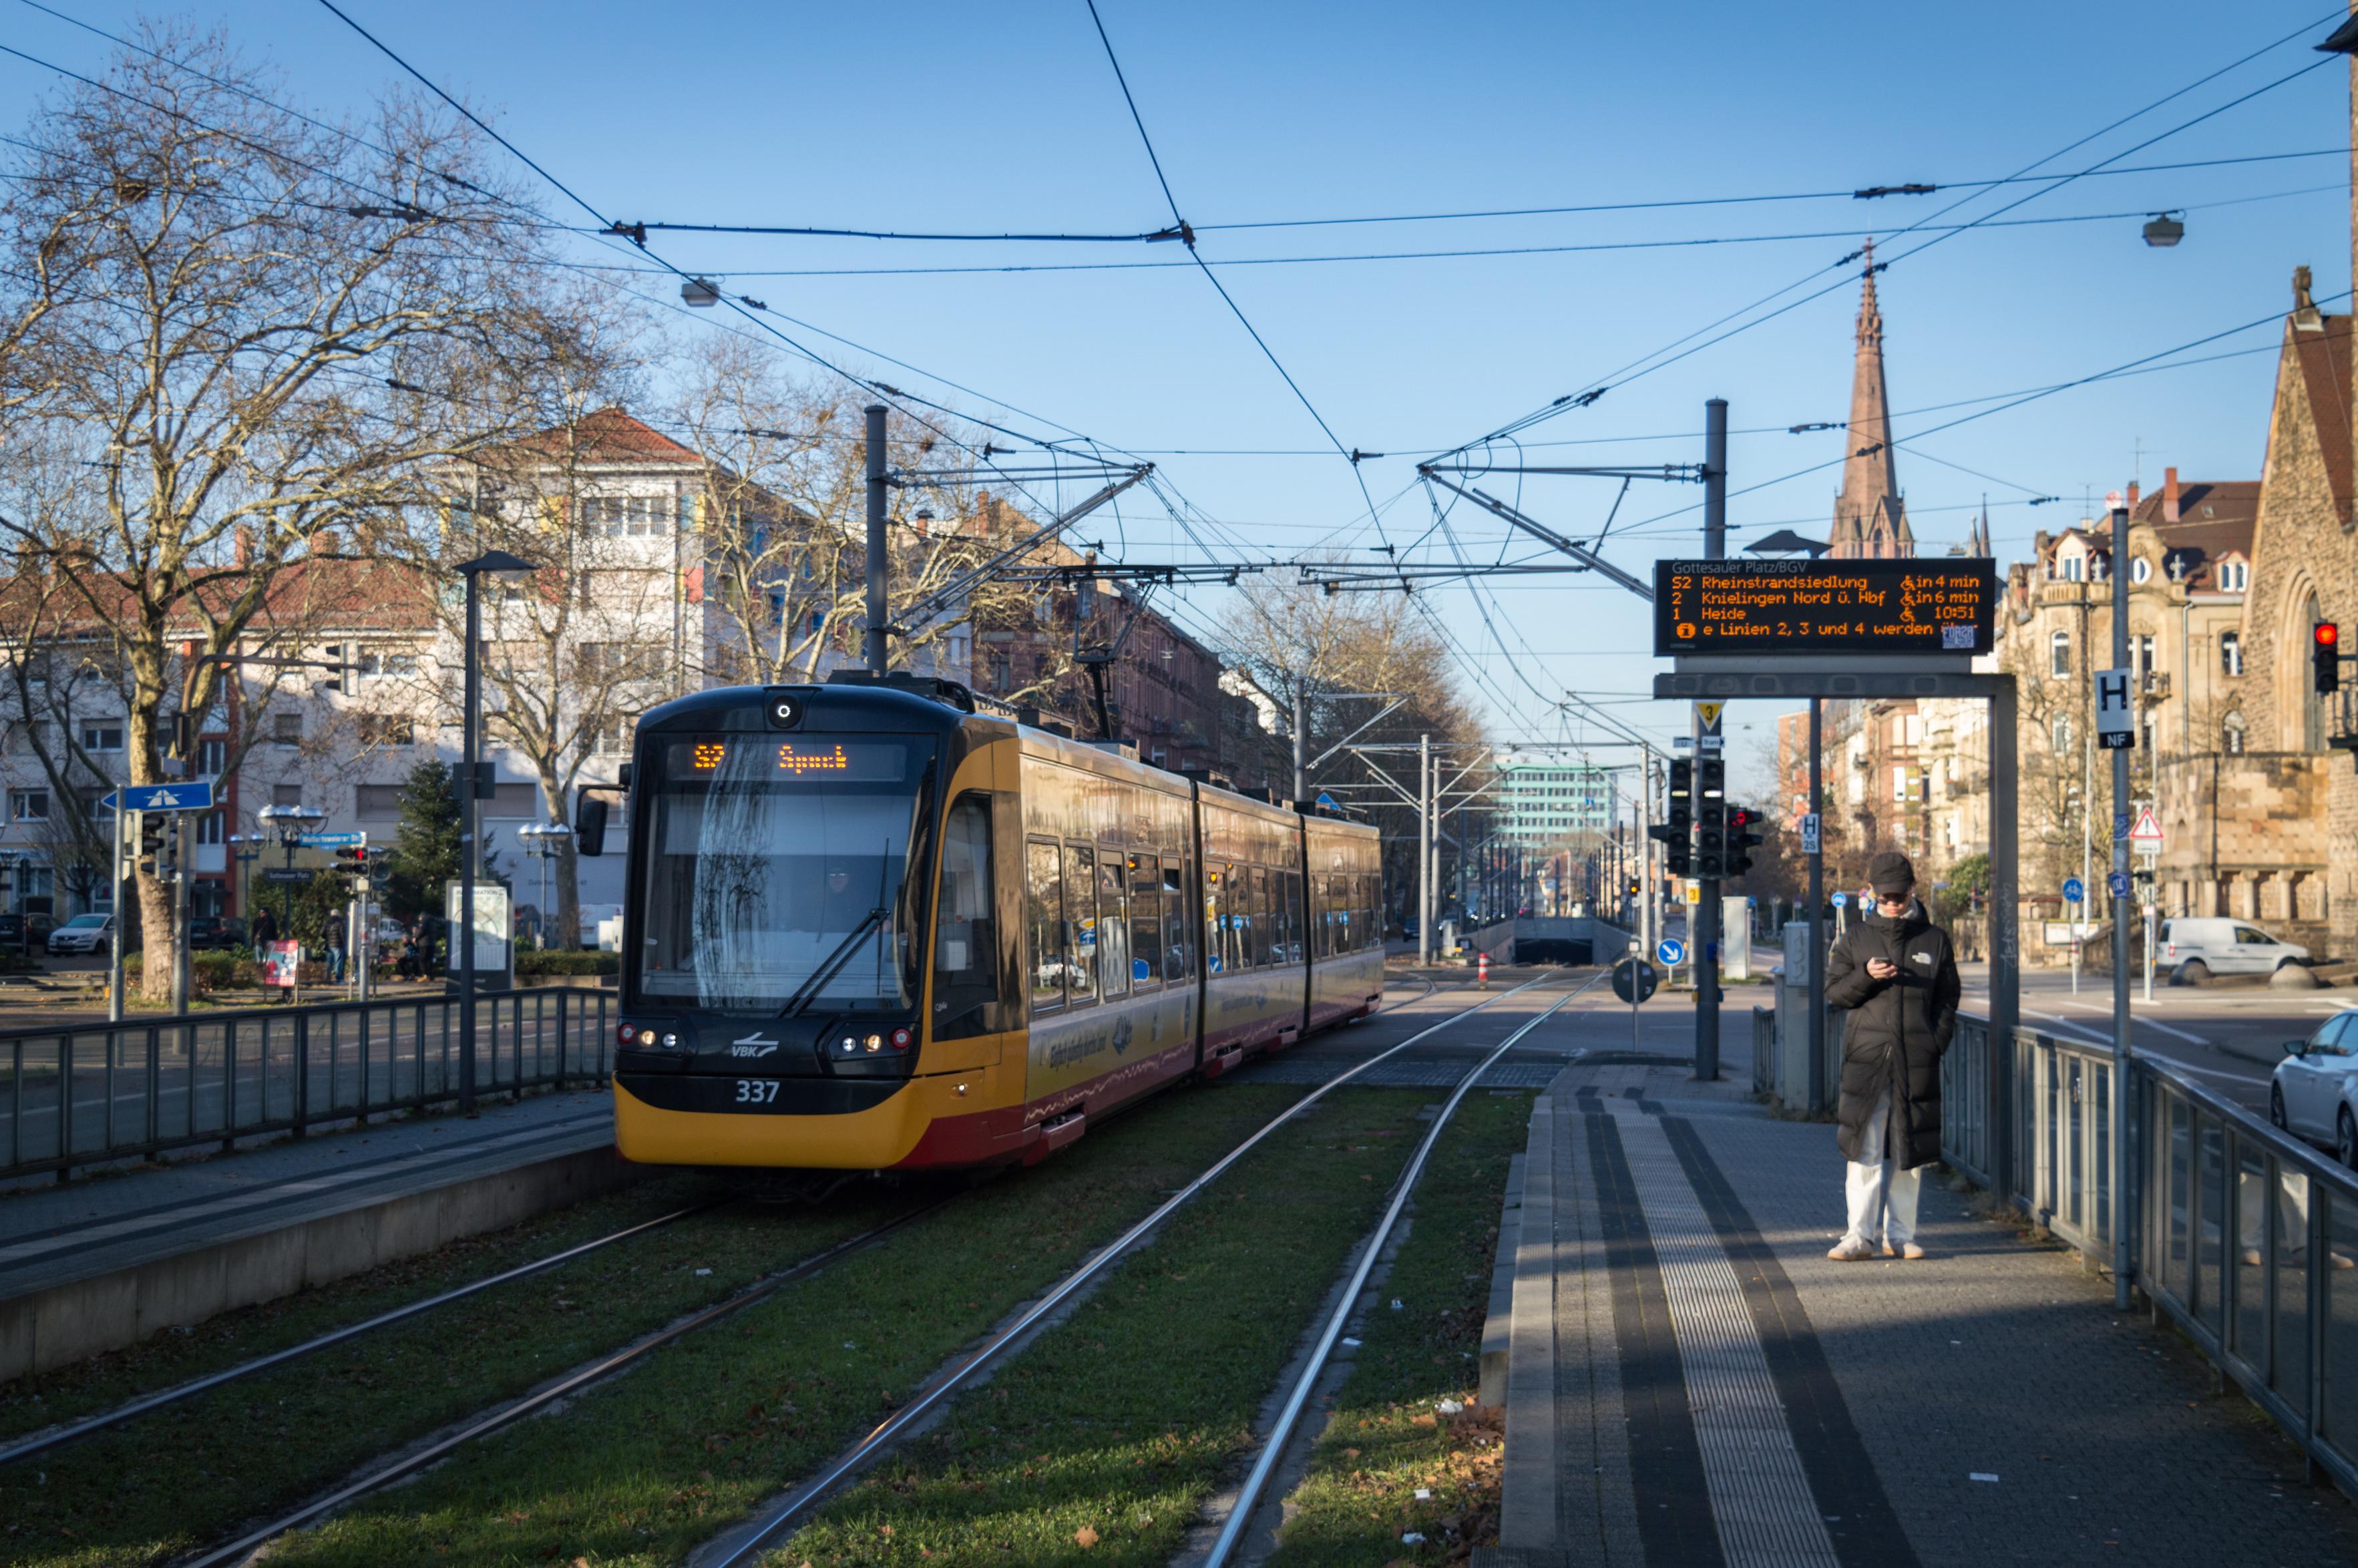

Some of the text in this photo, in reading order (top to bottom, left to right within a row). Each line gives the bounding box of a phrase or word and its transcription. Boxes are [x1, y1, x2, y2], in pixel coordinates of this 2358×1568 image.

[1672, 561, 1808, 574] Gottesauer Platz/BGV
[1672, 575, 1980, 590] S2 Rheinstrandsiedlung in 4 min
[1672, 590, 1979, 607] 2 Knielingen Nord ü. Hbf in 6 min
[1673, 606, 1975, 620] 1 Heide 10:51
[1704, 625, 1714, 635] e
[1720, 622, 1770, 635] Linien
[1777, 622, 1792, 636] 2,
[1800, 622, 1809, 635] 3
[1818, 622, 1848, 635] und
[1855, 622, 1864, 634] 4
[1873, 622, 1933, 635] werden
[2100, 674, 2127, 711] H
[1706, 705, 1713, 721] 3
[2107, 733, 2126, 747] NF
[1804, 817, 1816, 834] H
[1689, 889, 1696, 900] 3
[732, 1046, 758, 1057] VBK
[736, 1080, 780, 1103] 337
